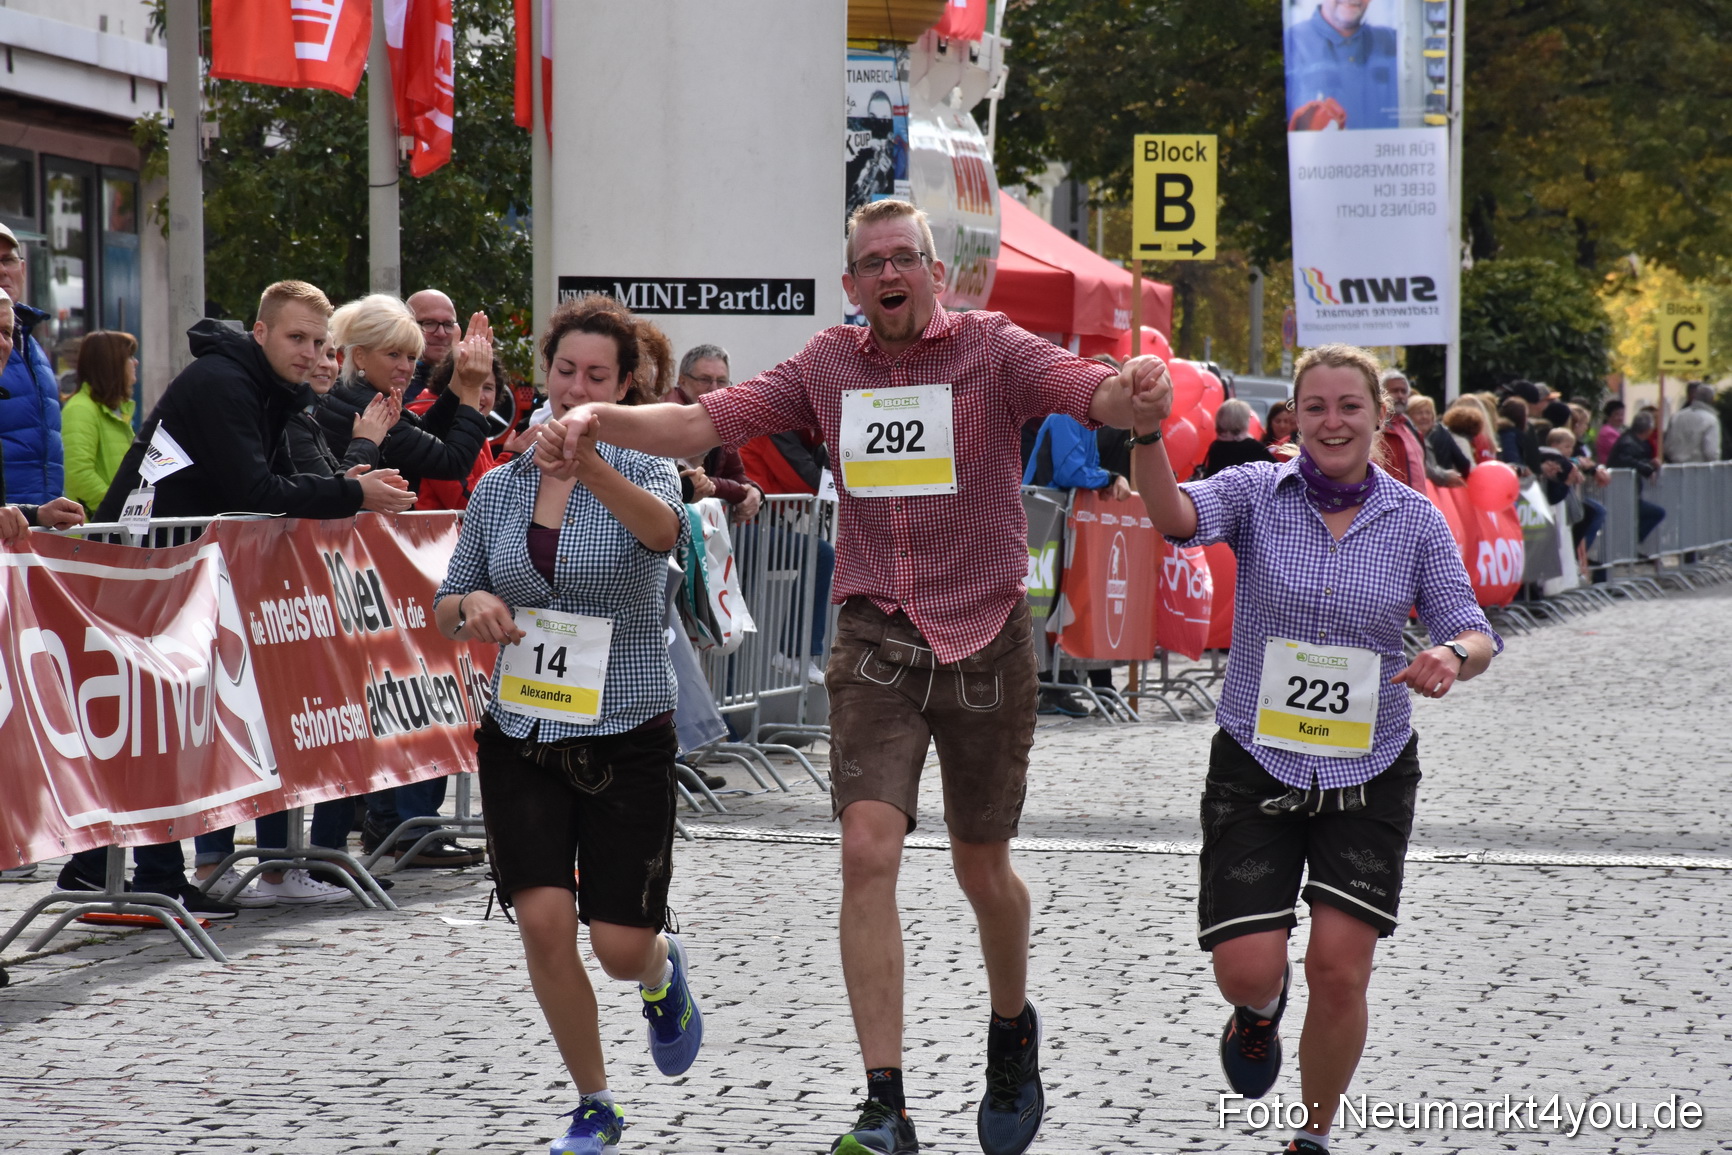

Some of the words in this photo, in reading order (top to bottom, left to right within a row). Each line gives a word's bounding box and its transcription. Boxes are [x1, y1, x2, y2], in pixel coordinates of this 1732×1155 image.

[1144, 140, 1207, 162] Block
[1155, 172, 1196, 232] B
[560, 282, 805, 311] wwMINI-Partl.de
[1666, 303, 1704, 315] Block
[1672, 320, 1696, 354] C
[883, 396, 920, 407] BOCK
[866, 420, 925, 454] 292
[260, 580, 336, 645] meisten
[407, 596, 428, 629] die
[542, 620, 578, 634] BOCK
[533, 643, 567, 678] 14
[1307, 654, 1348, 668] BOCK
[520, 684, 572, 703] Alexandra
[1286, 676, 1349, 714] 223
[291, 696, 370, 751] schönsten
[1299, 721, 1330, 737] Karin
